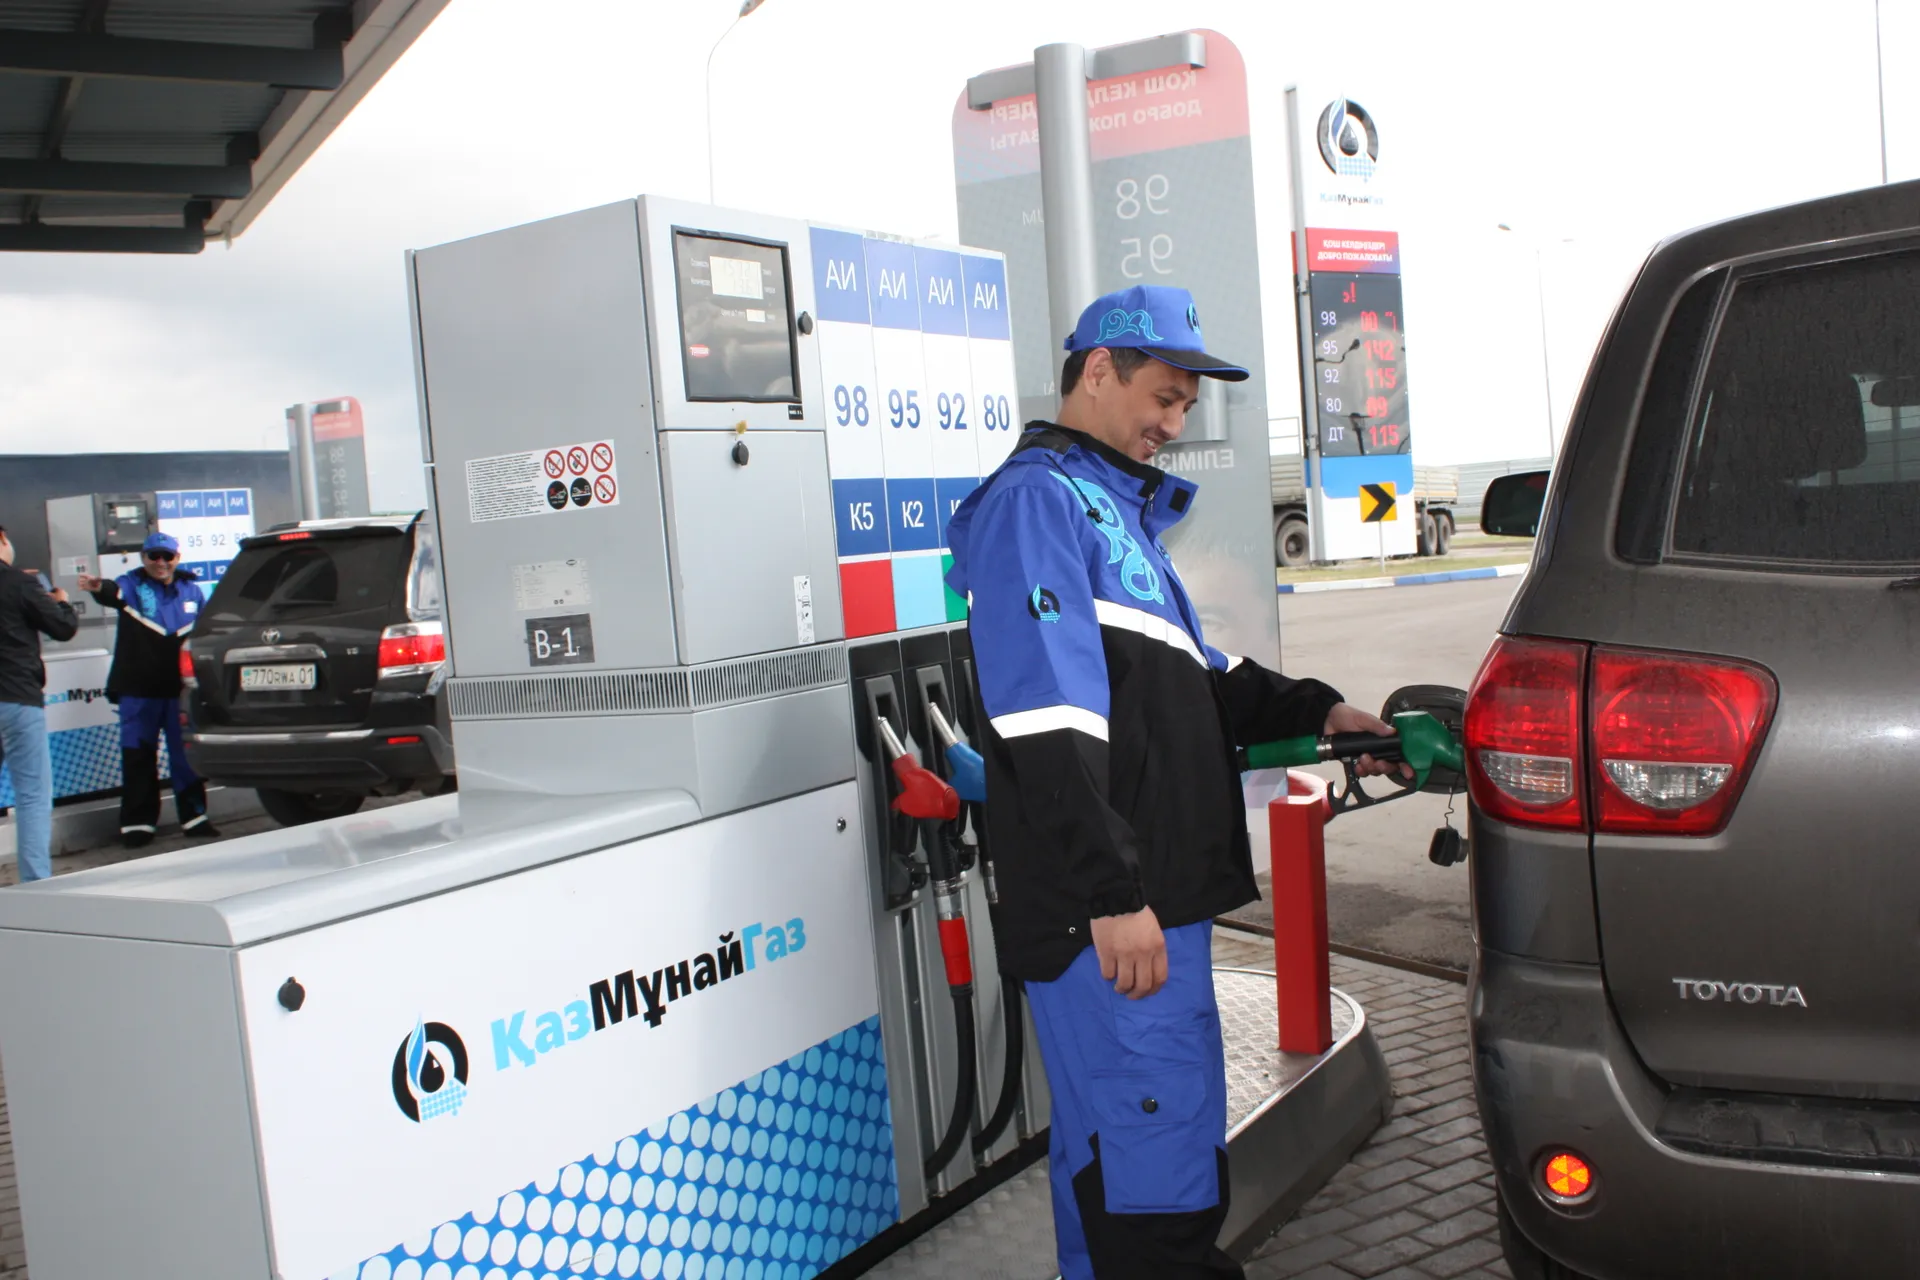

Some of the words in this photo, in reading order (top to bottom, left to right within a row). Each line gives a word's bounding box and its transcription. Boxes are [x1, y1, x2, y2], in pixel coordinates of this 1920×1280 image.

[1317, 251, 1342, 261] ДОБРО
[825, 259, 857, 292] АИ
[878, 268, 907, 301] АИ
[928, 276, 954, 307] АИ
[973, 282, 998, 311] АИ
[1321, 311, 1337, 326] 98
[1322, 340, 1338, 355] 95
[1363, 339, 1395, 361] 142
[1324, 368, 1340, 384] 92
[1365, 367, 1397, 389] 115
[833, 384, 870, 427] 98
[888, 388, 921, 429] 95
[936, 392, 967, 430] 92
[983, 394, 1010, 432] 80
[1326, 397, 1342, 412] 80
[1328, 426, 1344, 443] ДТ
[1369, 424, 1400, 447] 115
[187, 535, 203, 548] 95
[211, 533, 227, 547] 92
[299, 667, 314, 684] 01
[490, 917, 807, 1071] ҚазМұнайГаз
[1672, 977, 1808, 1008] TOYOTA
